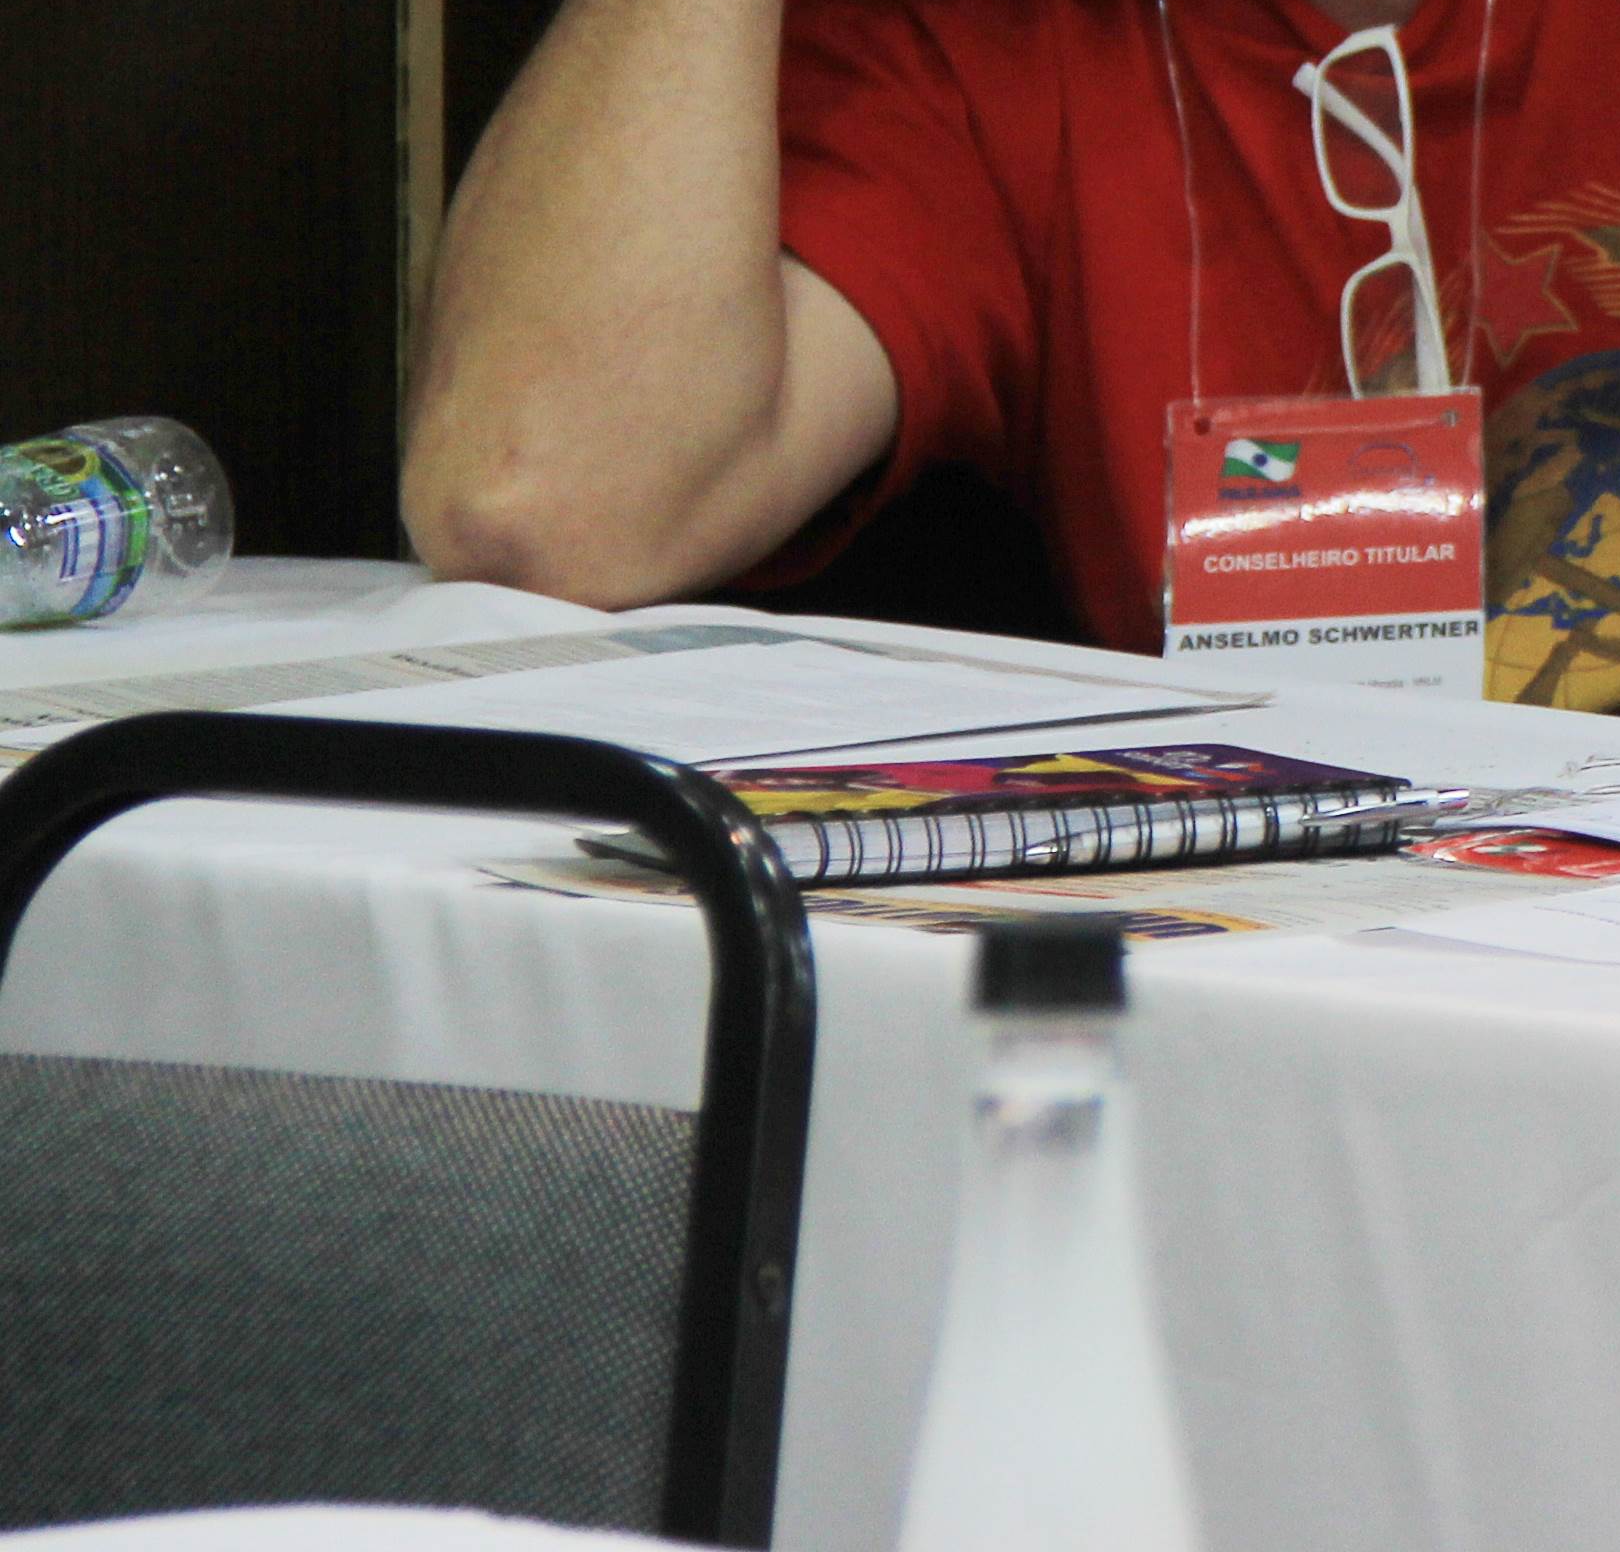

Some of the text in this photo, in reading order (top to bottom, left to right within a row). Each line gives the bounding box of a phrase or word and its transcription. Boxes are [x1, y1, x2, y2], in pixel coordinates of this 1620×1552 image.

[1203, 543, 1455, 574] CONSELHEIRO TITULAR
[1177, 619, 1479, 653] ANSELMO SCHWERTNER
